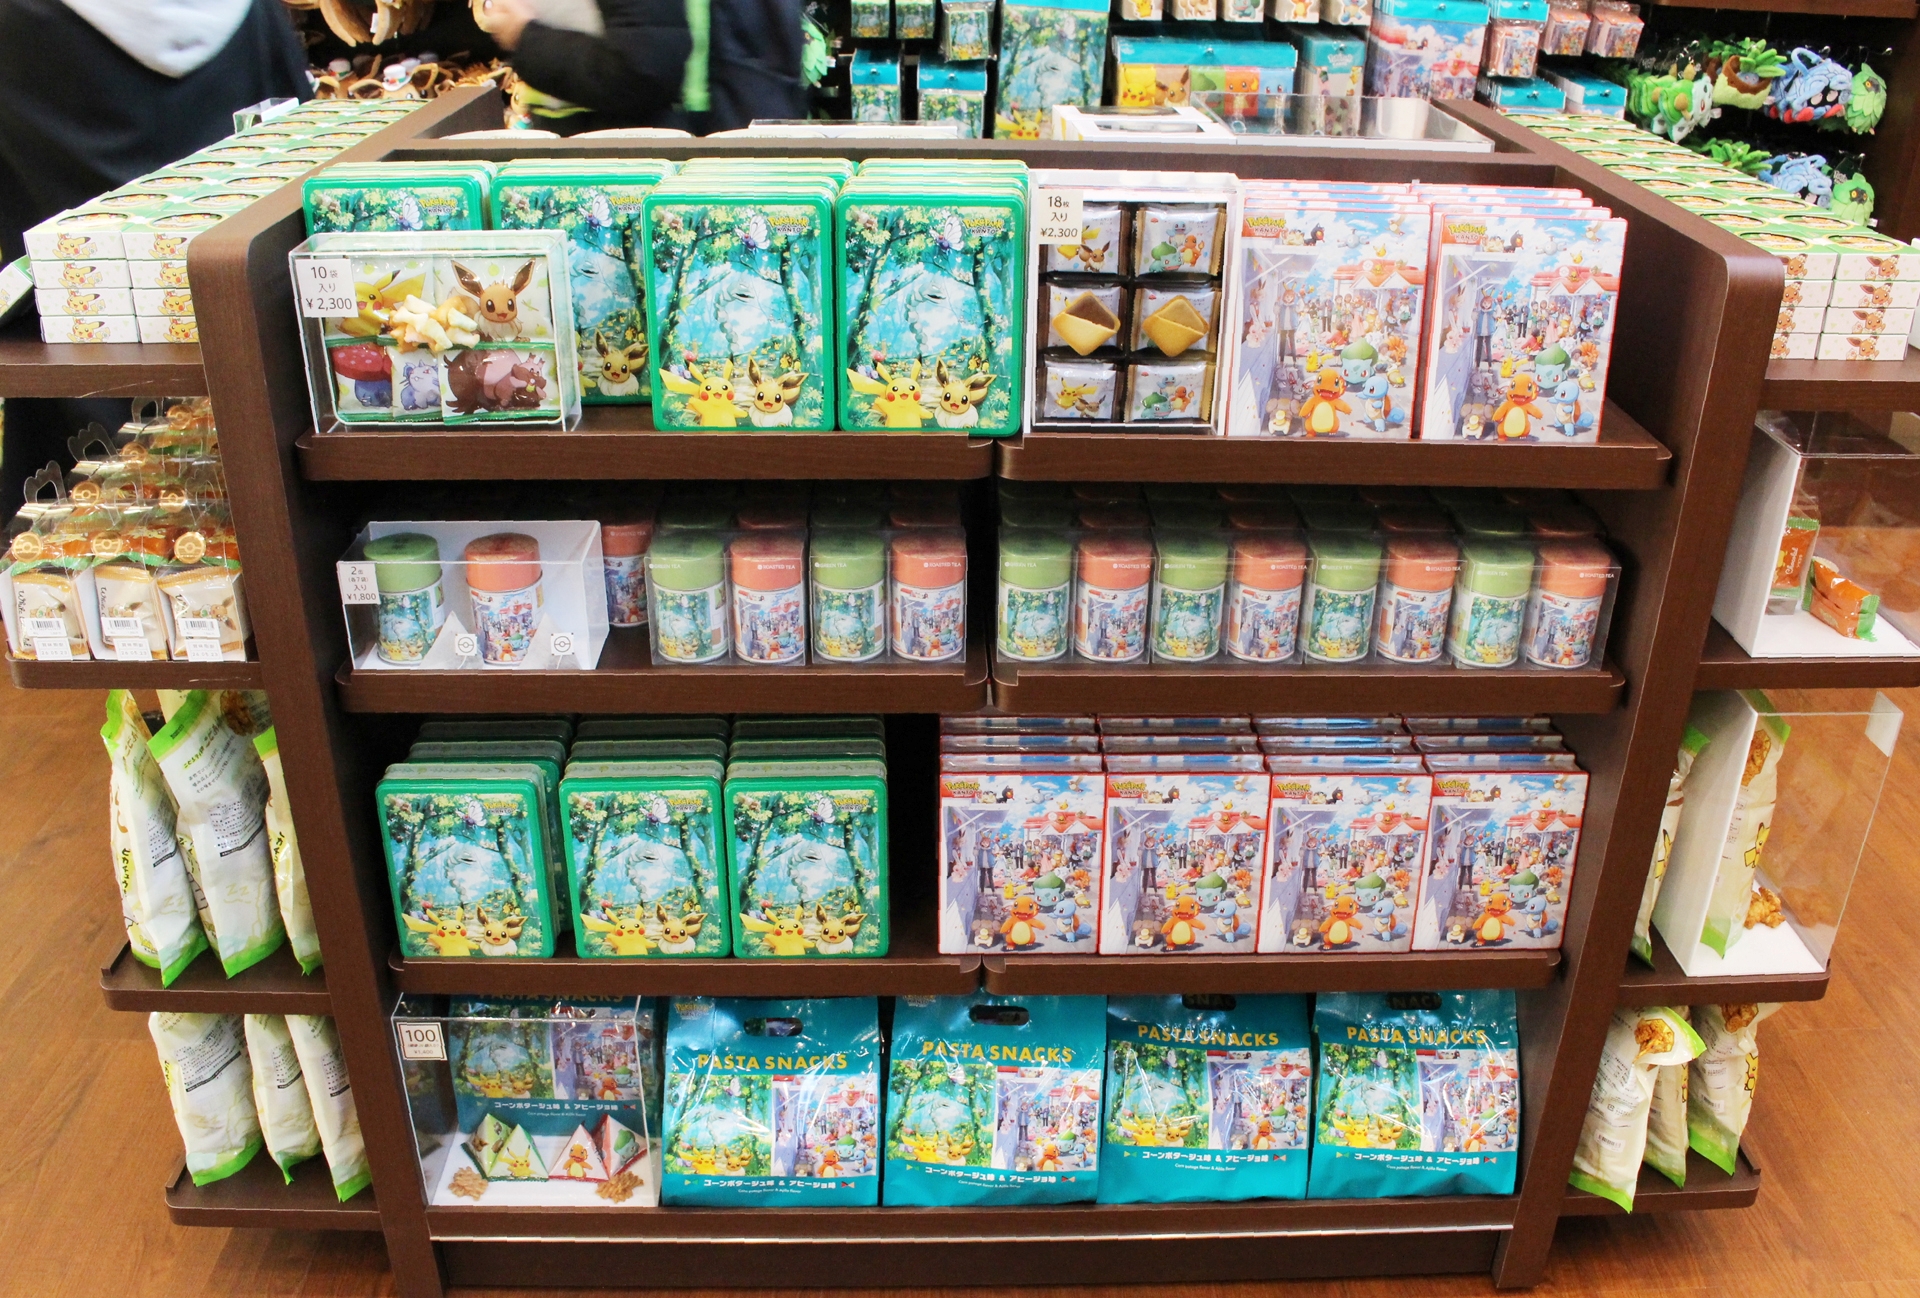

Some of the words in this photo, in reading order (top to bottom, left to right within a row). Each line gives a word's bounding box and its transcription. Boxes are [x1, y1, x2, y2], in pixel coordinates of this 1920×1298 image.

[1051, 212, 1068, 222] 入り
[1041, 228, 1078, 238] ¥2,300
[318, 283, 336, 293] 入り
[1138, 1025, 1195, 1043] PASTA
[1201, 1029, 1279, 1046] SNACKS
[1347, 1026, 1405, 1043] PASTA
[1408, 1029, 1488, 1045] SNACKS
[922, 1042, 984, 1058] PASTA
[990, 1046, 1072, 1062] SNACKS
[698, 1054, 760, 1070] PASTA
[765, 1054, 848, 1070] SNACKS
[1142, 1151, 1211, 1162] コーンポタージュ味
[1225, 1154, 1269, 1162] アヒージョ味
[1354, 1153, 1423, 1163] コーンポタージュ味
[1436, 1156, 1480, 1166] アヒージョ味
[925, 1166, 995, 1181] コーンポタージュ味
[1010, 1175, 1056, 1183] アヒージョ味
[704, 1179, 774, 1187] コーンポタージュ味
[789, 1180, 836, 1189] アヒージョ味
